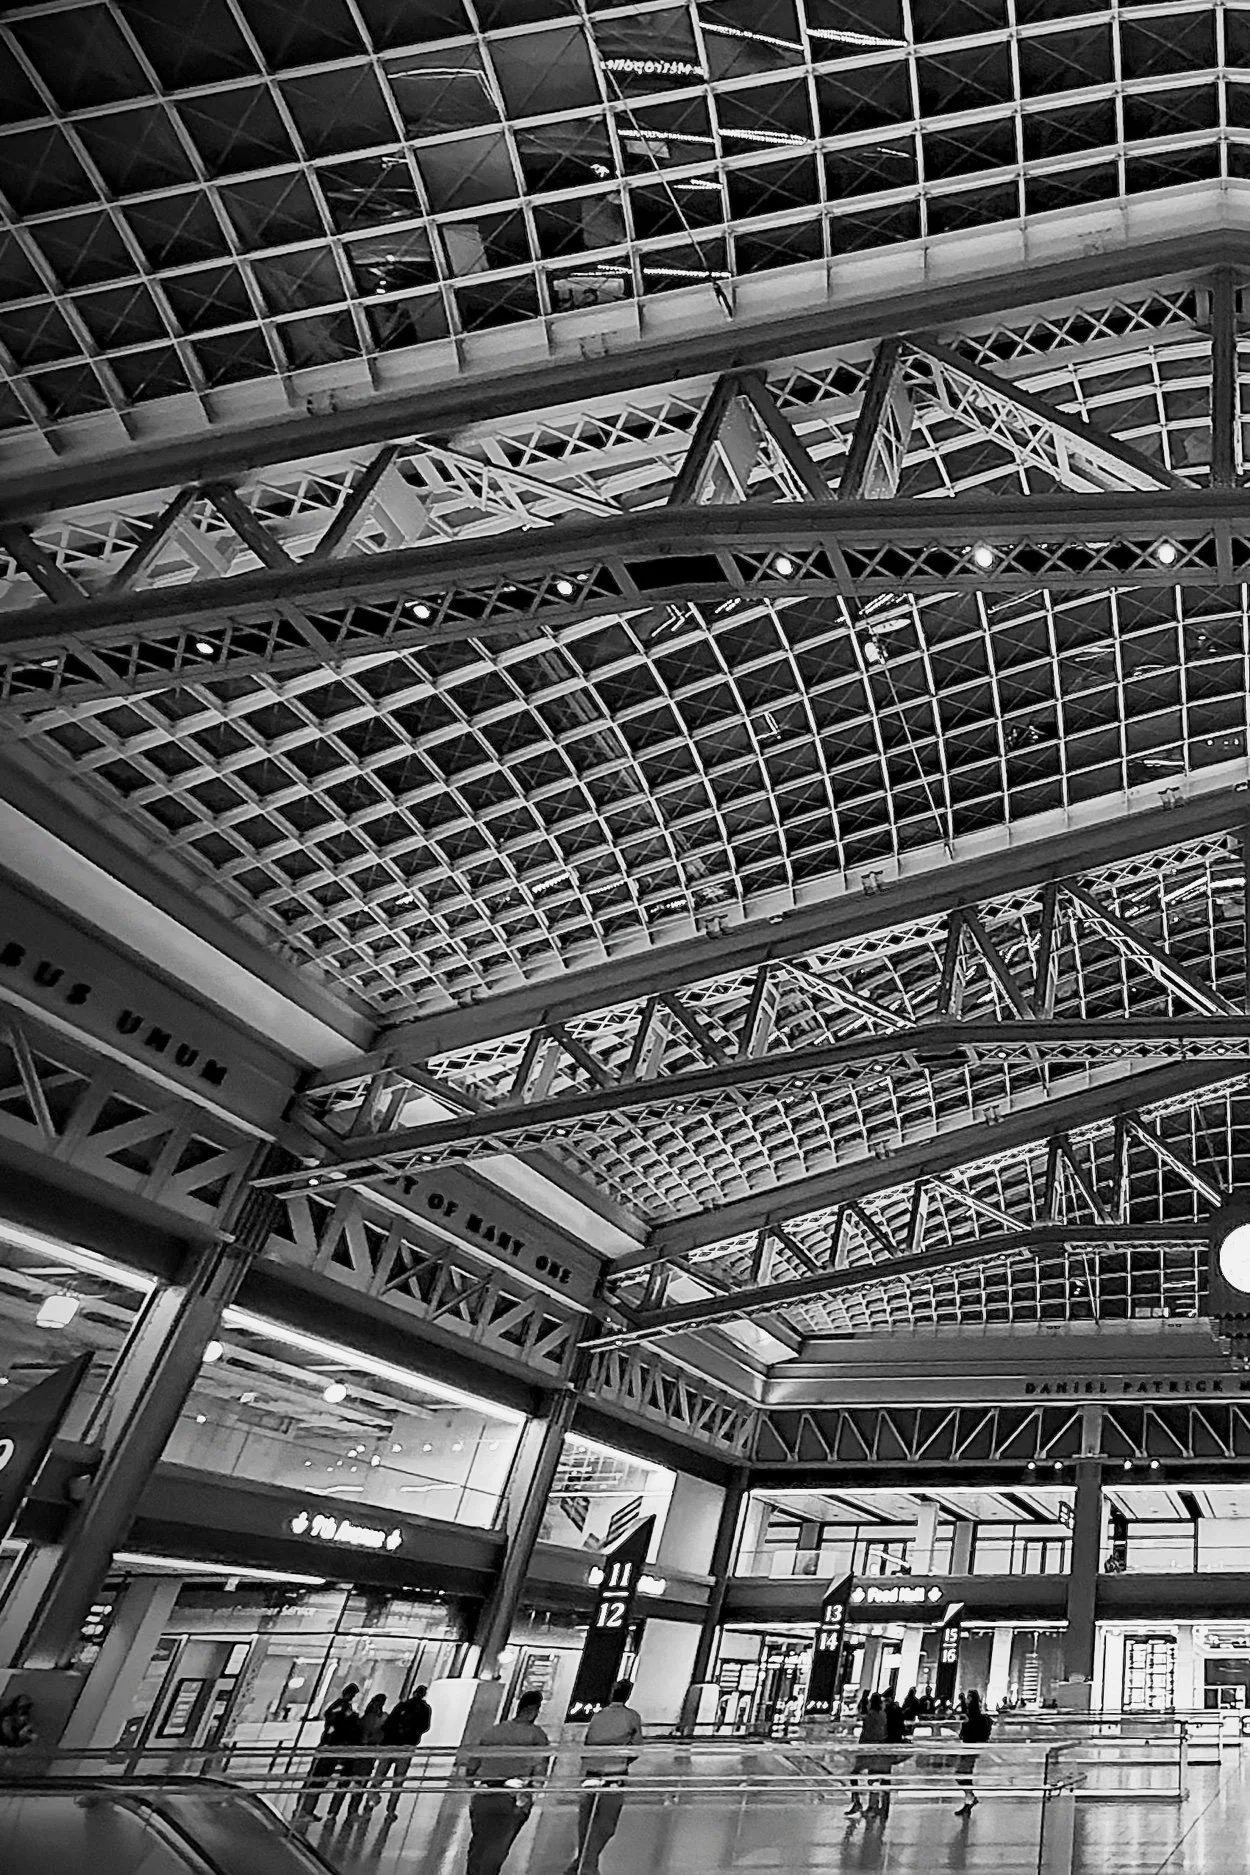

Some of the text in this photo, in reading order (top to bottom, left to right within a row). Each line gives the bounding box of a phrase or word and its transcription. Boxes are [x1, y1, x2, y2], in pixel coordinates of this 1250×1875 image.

[116, 1010, 228, 1086] UNUM
[427, 1193, 572, 1284] OF MANY ONE
[1025, 1381, 1107, 1394] DANIEL
[1122, 1380, 1224, 1393] PATRICK
[609, 1562, 632, 1587] 11
[596, 1602, 625, 1627] 12
[824, 1604, 843, 1622] 13
[819, 1631, 839, 1650] 14
[944, 1627, 958, 1642] 15
[942, 1648, 957, 1663] 16
